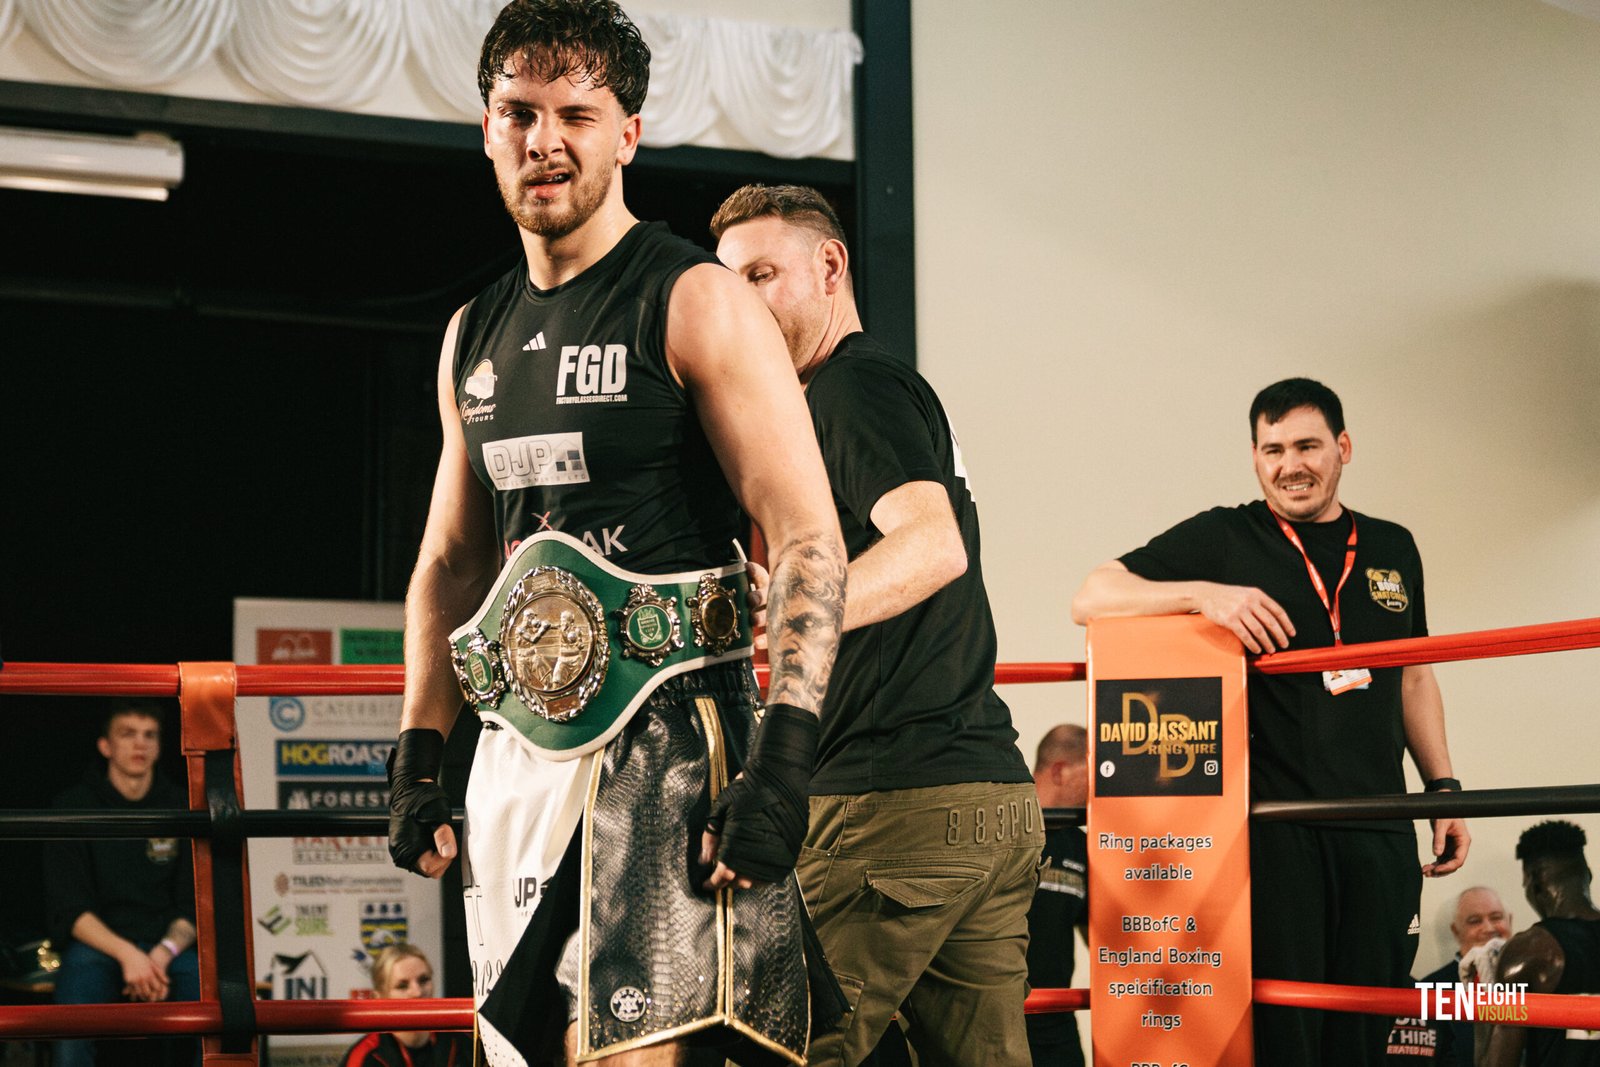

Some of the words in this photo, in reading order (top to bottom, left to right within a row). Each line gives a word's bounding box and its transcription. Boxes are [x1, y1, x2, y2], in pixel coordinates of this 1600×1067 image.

[556, 344, 628, 396] FGD
[472, 414, 494, 423] TOURS
[486, 439, 551, 480] DJP
[1100, 722, 1146, 742] DAVID
[1148, 720, 1218, 742] BASSANT
[1149, 744, 1184, 755] RING
[1185, 743, 1217, 754] HIRE
[1099, 834, 1134, 851] Ring
[1140, 834, 1212, 851] packages
[1125, 865, 1192, 880] available
[1122, 917, 1180, 932] BBBofC
[1186, 917, 1197, 932] &
[1099, 948, 1162, 966] England
[1169, 948, 1221, 967] Boxing
[1109, 980, 1213, 997] speicification
[1142, 1012, 1181, 1029] rings
[1400, 1029, 1437, 1047] HIRE
